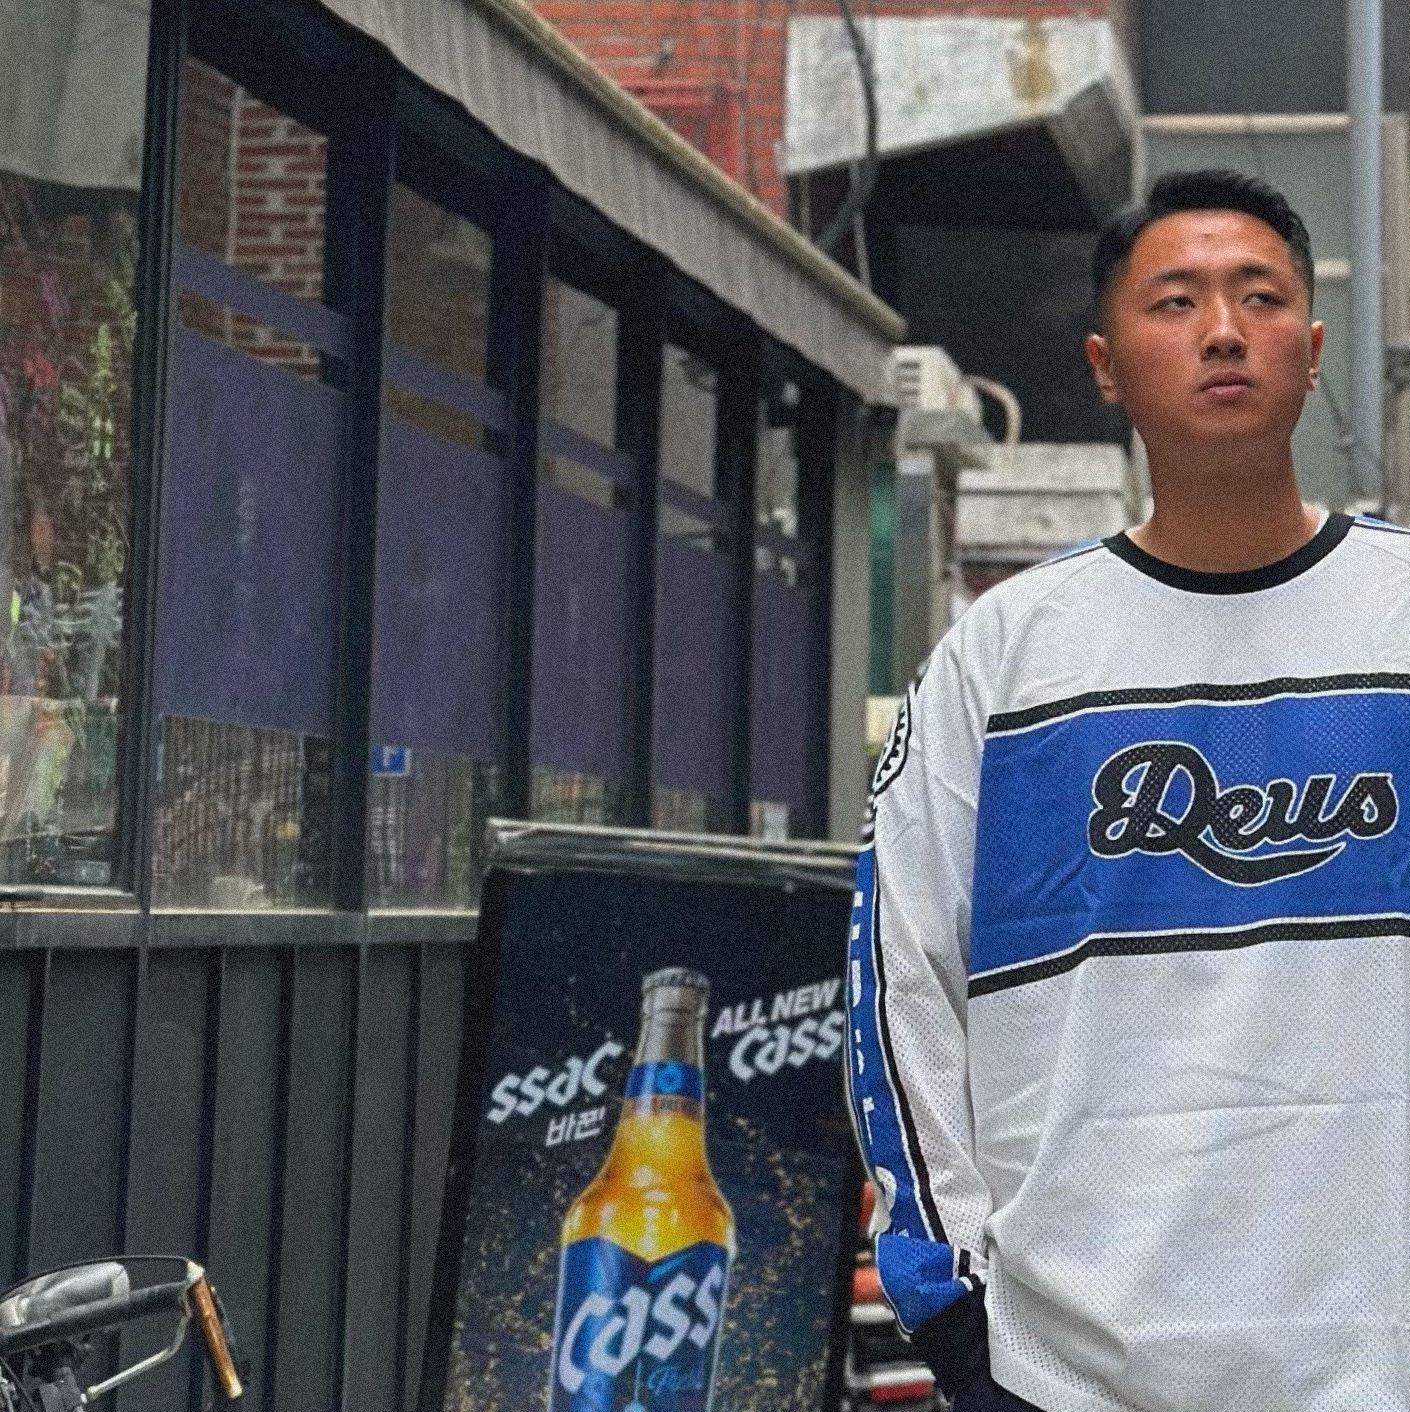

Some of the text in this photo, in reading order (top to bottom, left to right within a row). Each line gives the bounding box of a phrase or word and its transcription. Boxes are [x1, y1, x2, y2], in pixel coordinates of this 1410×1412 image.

[1087, 741, 1399, 887] Deus
[711, 977, 842, 1039] ALL NEW
